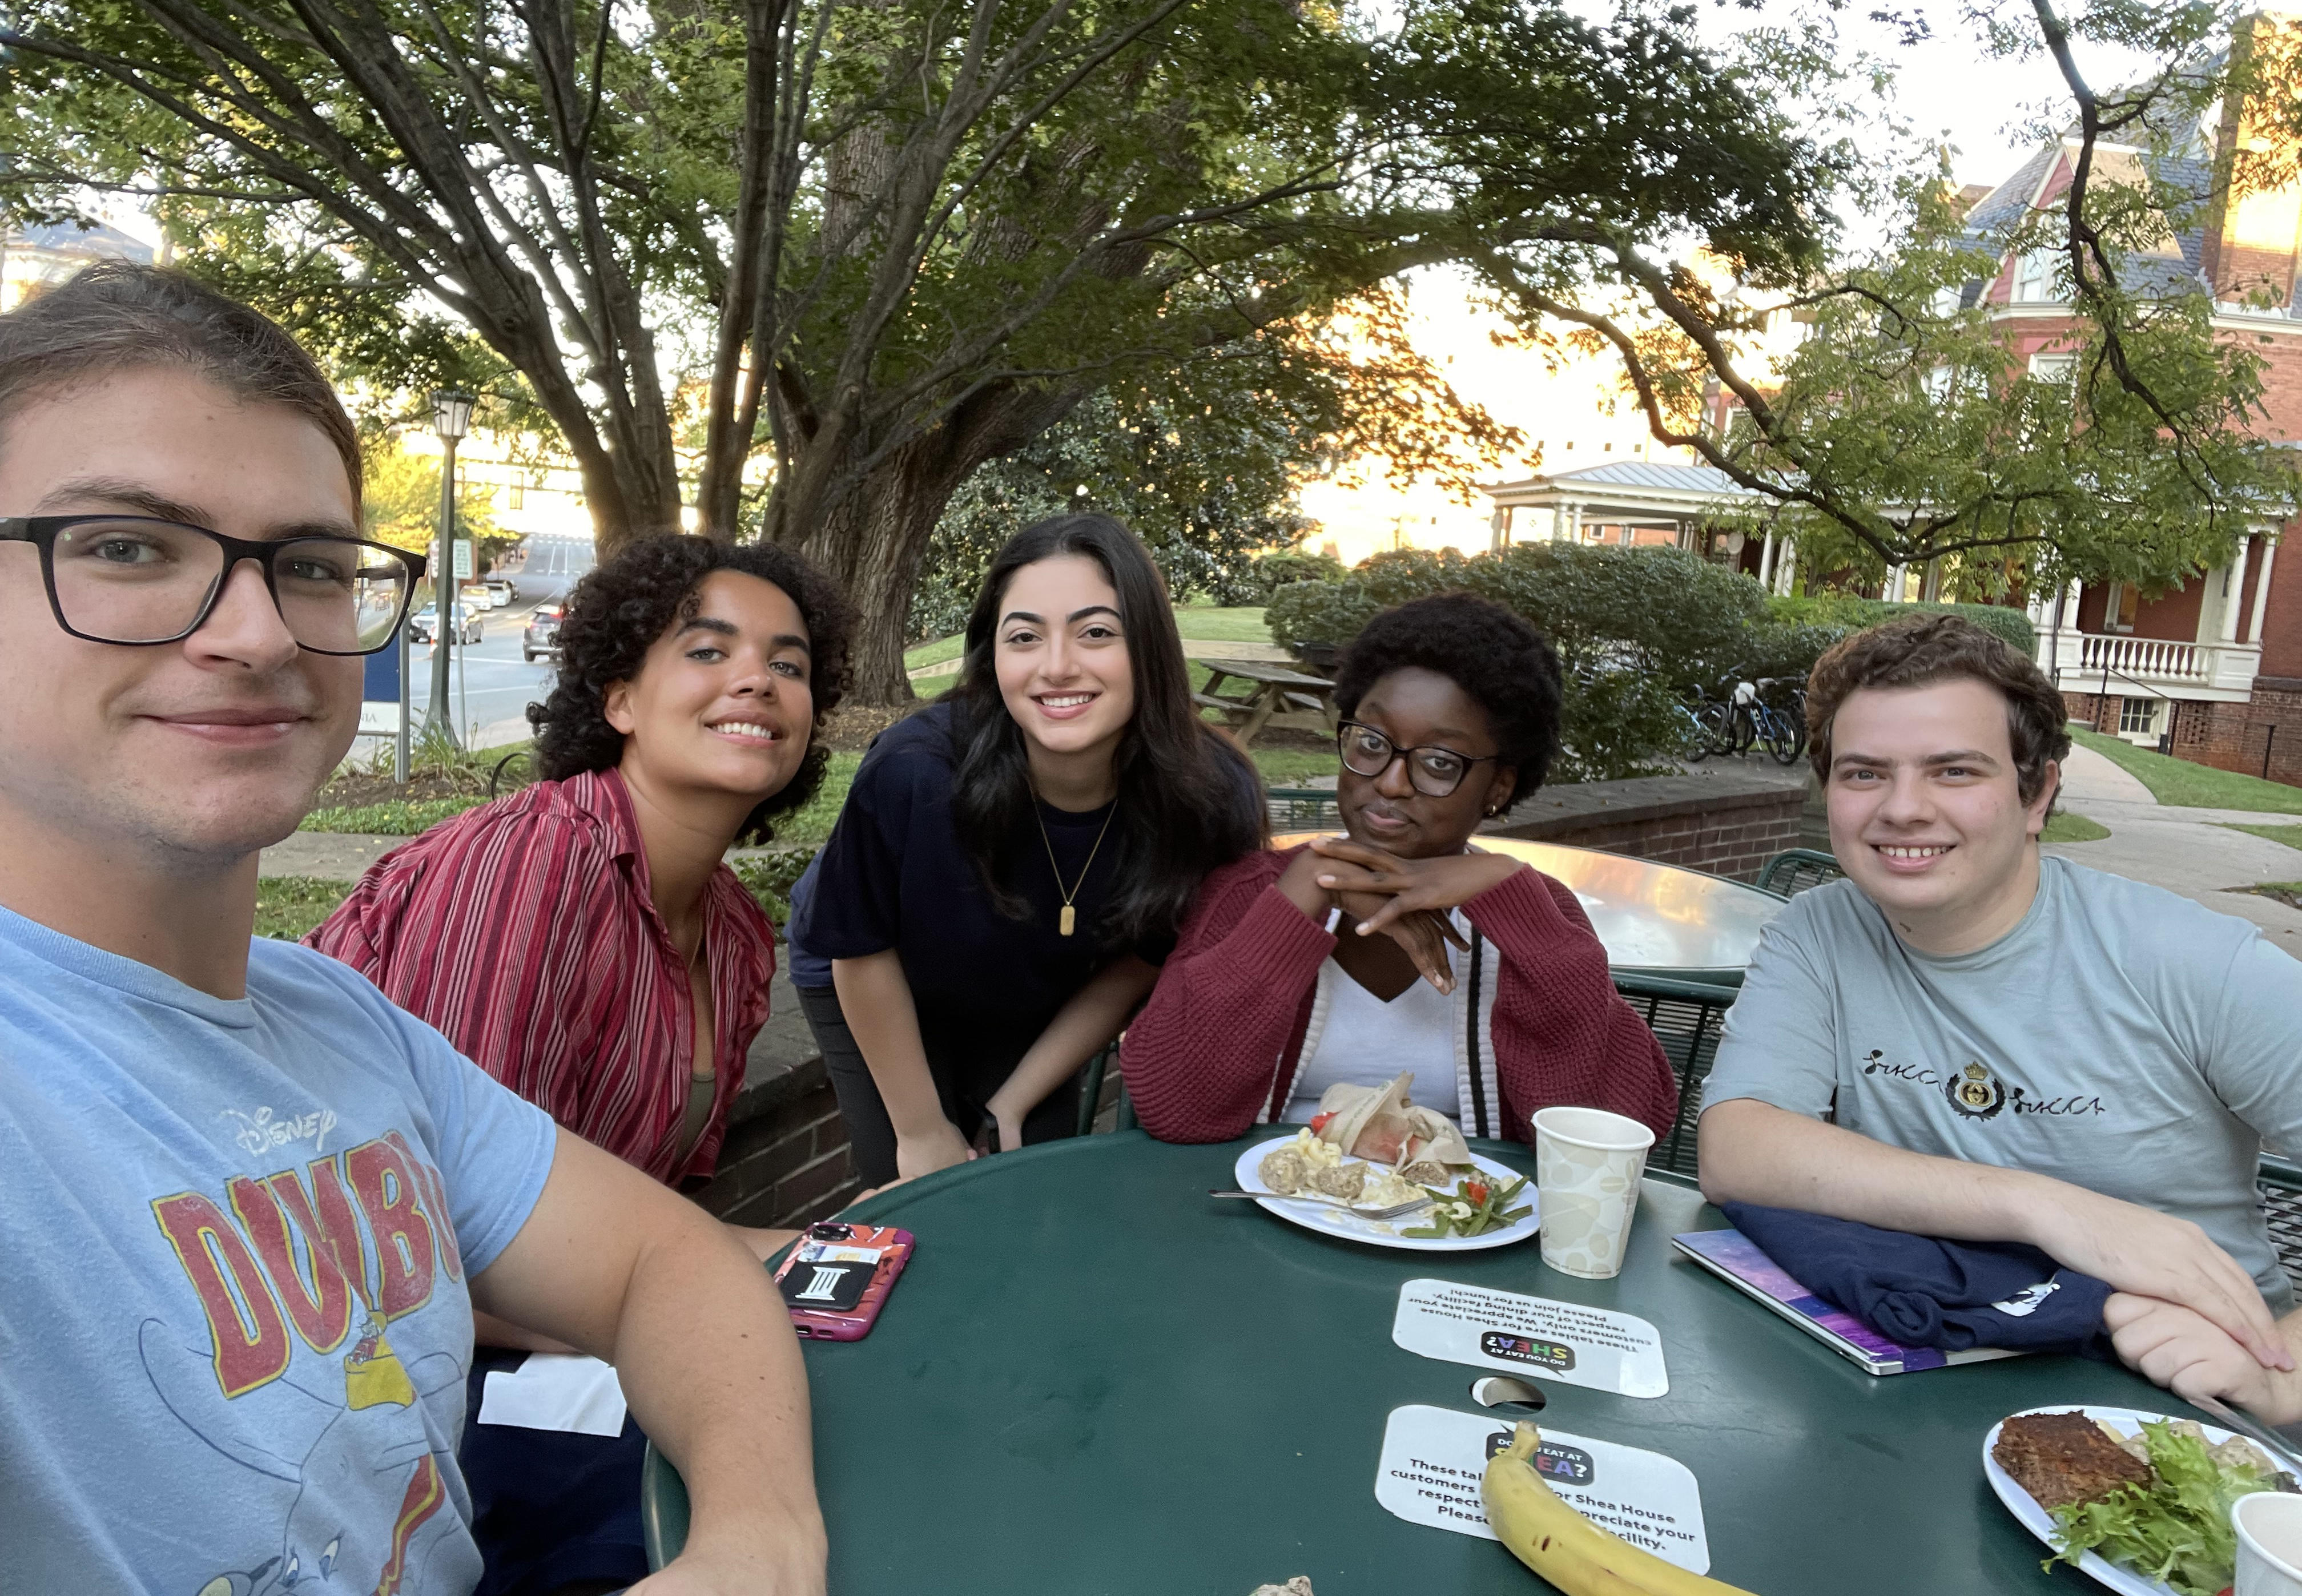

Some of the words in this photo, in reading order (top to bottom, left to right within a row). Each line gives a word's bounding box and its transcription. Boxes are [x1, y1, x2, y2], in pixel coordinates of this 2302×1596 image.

[1433, 1293, 1480, 1307] facility.
[1450, 1289, 1490, 1301] lunch!
[1408, 1298, 1438, 1307] your
[1484, 1302, 1528, 1314] dining
[1535, 1304, 1560, 1313] join
[1420, 1308, 1462, 1320] House
[1442, 1303, 1513, 1319] appreciate
[1563, 1309, 1607, 1322] Please
[1466, 1316, 1499, 1327] Shea
[1502, 1322, 1522, 1331] for
[1516, 1317, 1537, 1325] We
[1543, 1320, 1576, 1331] only.
[1575, 1319, 1625, 1333] respect
[1551, 1331, 1593, 1344] tables
[1580, 1328, 1652, 1345] customers
[1486, 1336, 1567, 1359] SHEA?
[1597, 1339, 1639, 1353] These
[1526, 1354, 1548, 1363] YOU
[1544, 1448, 1565, 1457] EAT
[1410, 1458, 1456, 1475] These
[1576, 1494, 1616, 1510] Shea
[1621, 1504, 1676, 1524] House
[1418, 1489, 1480, 1508] respect
[1391, 1470, 1475, 1493] customers
[1655, 1526, 1696, 1542] your
